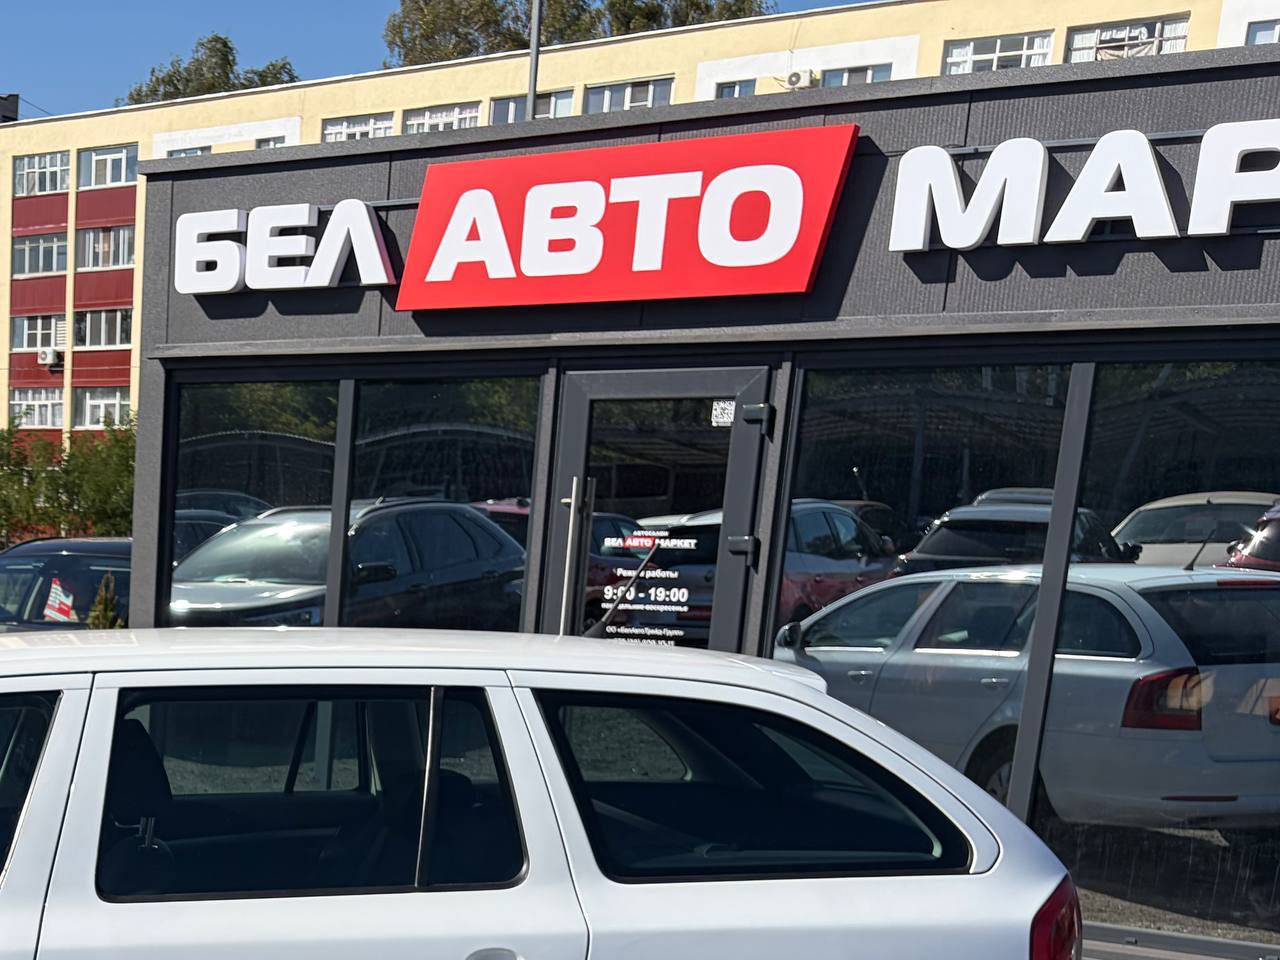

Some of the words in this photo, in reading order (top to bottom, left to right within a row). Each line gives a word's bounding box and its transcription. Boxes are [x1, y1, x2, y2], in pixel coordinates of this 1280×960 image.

[175, 199, 396, 295] БЕЛ
[425, 164, 803, 282] АВТО
[888, 118, 1280, 251] МАР
[625, 539, 653, 547] АВТО
[645, 568, 680, 579] работы
[648, 587, 689, 602] 19:00
